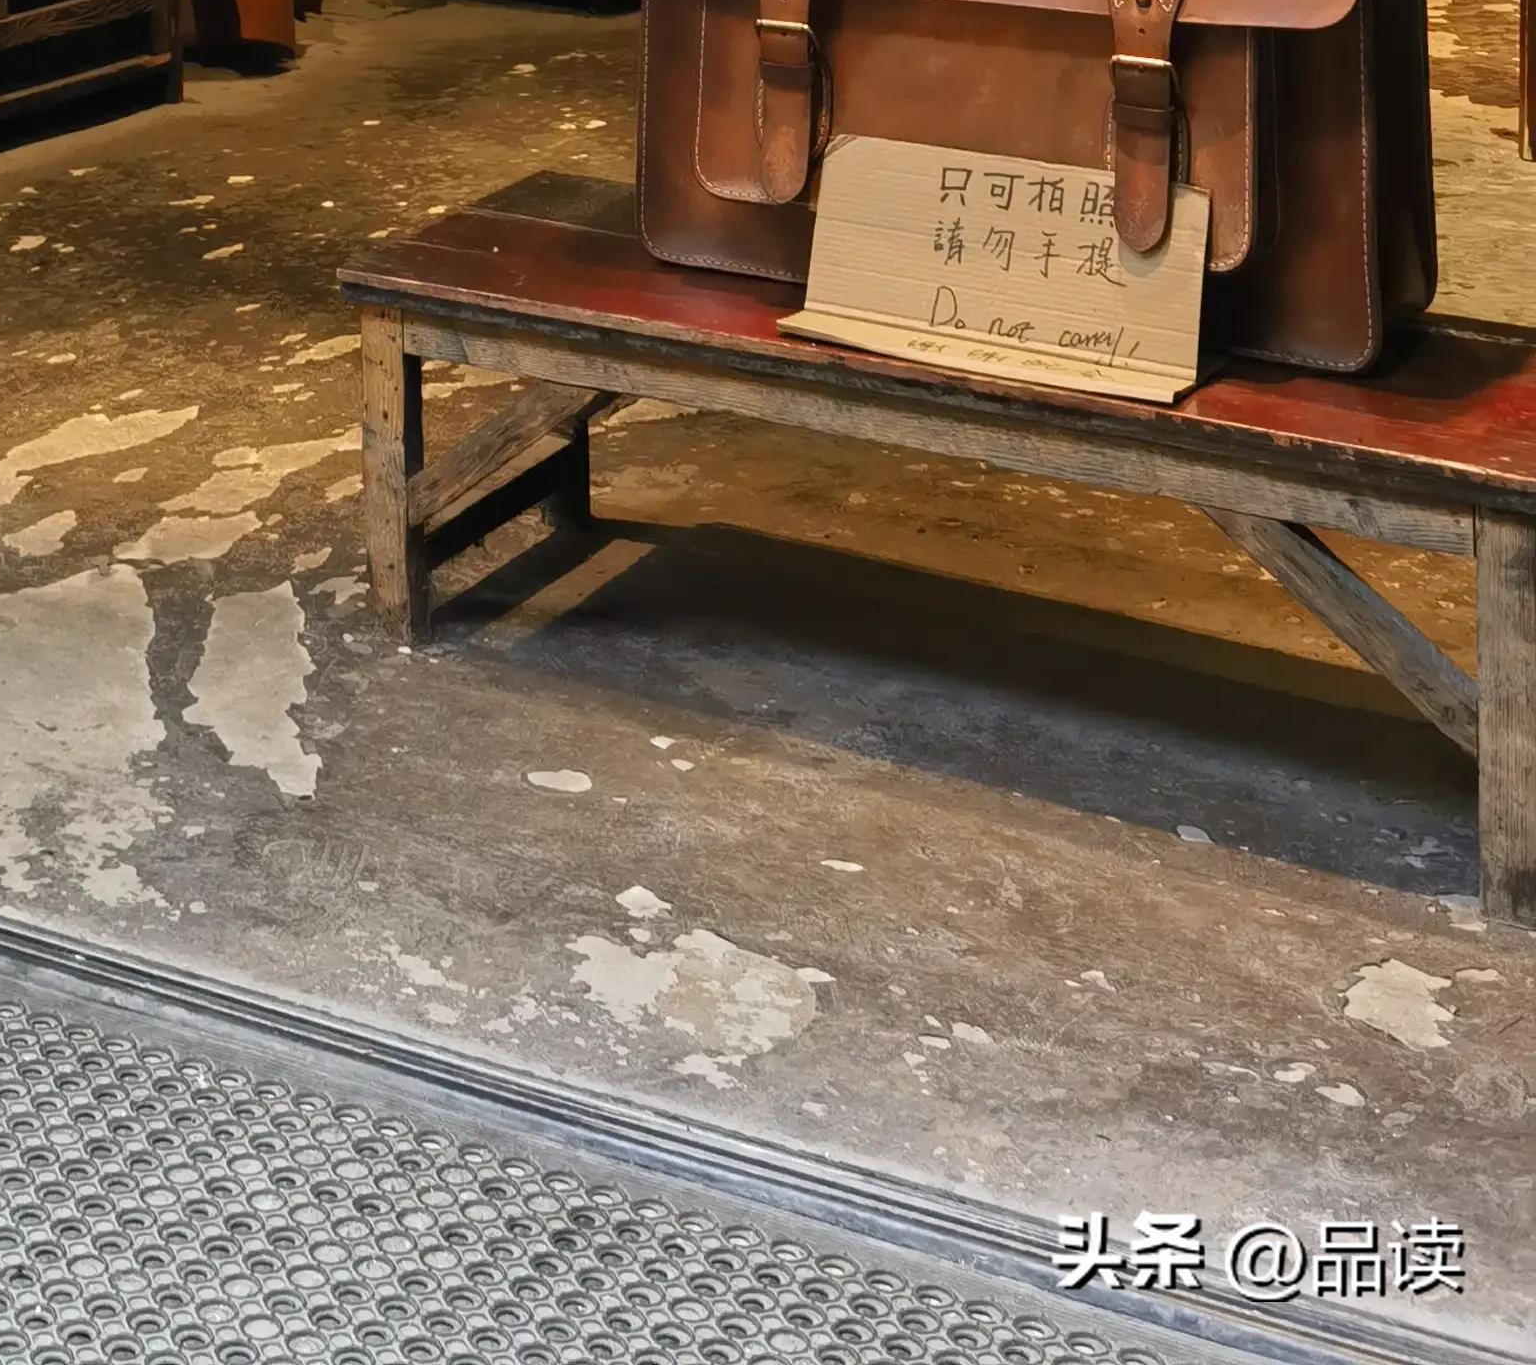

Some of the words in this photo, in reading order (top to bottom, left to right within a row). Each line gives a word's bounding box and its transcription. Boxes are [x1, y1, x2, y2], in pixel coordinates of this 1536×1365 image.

[939, 166, 1116, 229] 只可拍照
[928, 285, 966, 330] Do
[988, 316, 1034, 344] not
